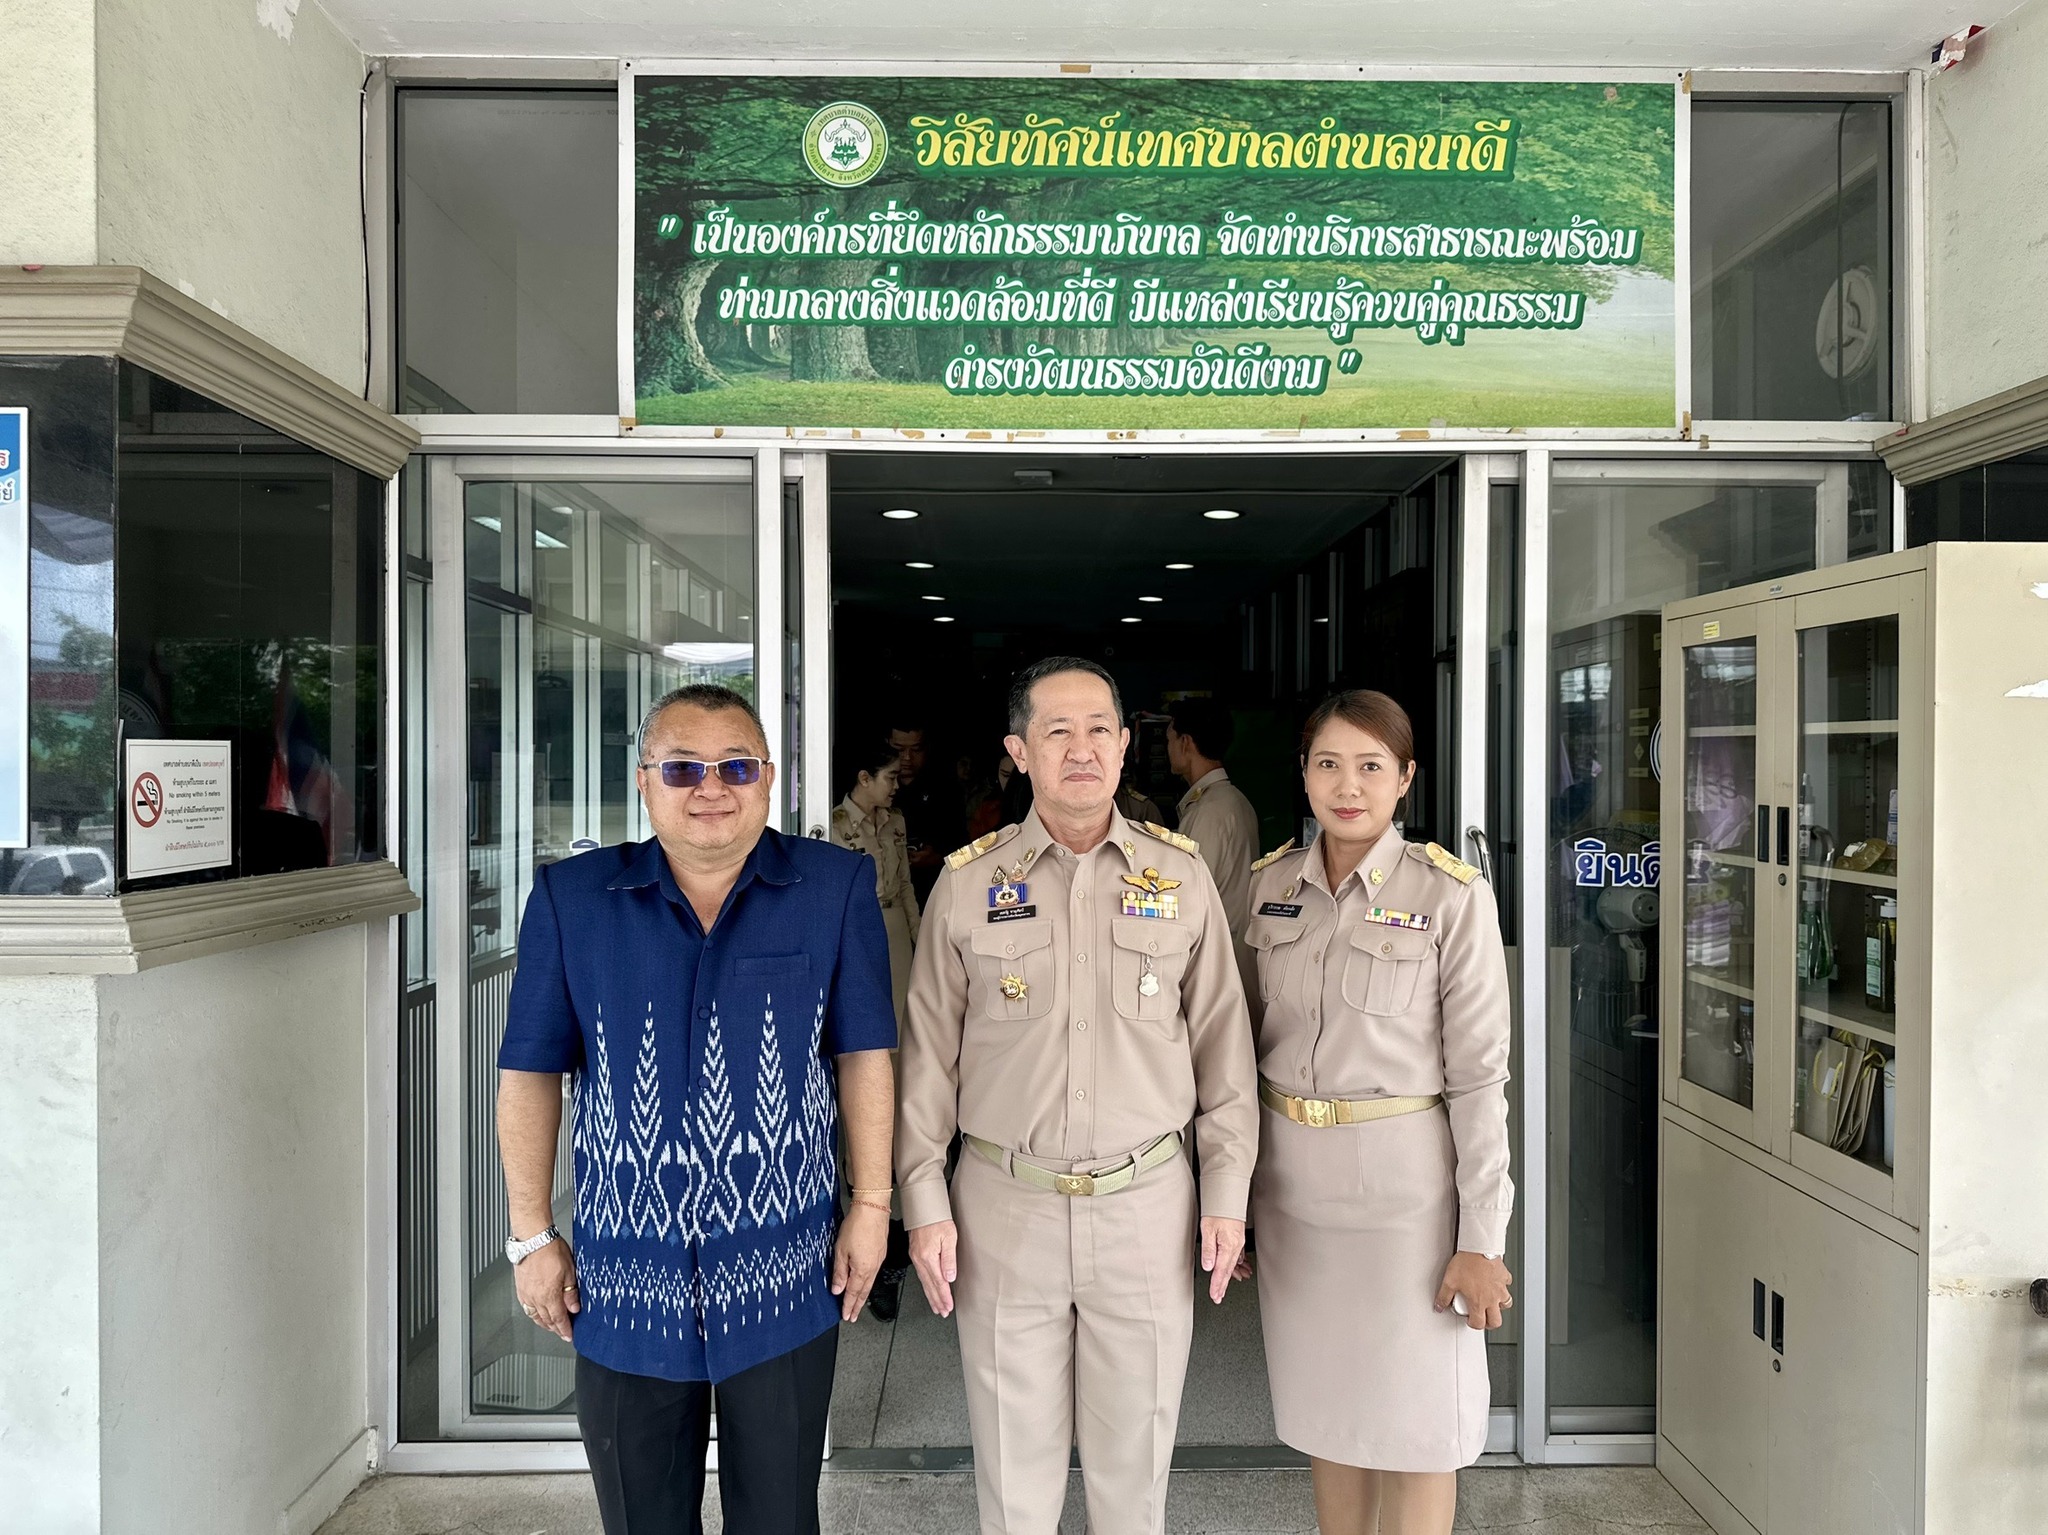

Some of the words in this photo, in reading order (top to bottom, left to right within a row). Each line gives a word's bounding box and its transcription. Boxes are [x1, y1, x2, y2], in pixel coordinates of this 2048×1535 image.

[910, 111, 1511, 171] วิสัยทัศน์เทศบาลตำบลนาดี
[695, 200, 1201, 255] เป็นองค์กรที่ยึดหลักธรรมาภิบาล
[1217, 211, 1637, 259] จัดทำบริการสาธารณะพร้อม
[719, 266, 1117, 322] ท่ามกลางสิ่งแวดล้อมที่ดี
[1130, 277, 1579, 339] มีแหล่งเรียนรู้ควบคู่คุณธรรม
[945, 344, 1325, 389] ดำรงวัฒนธรรมอันดีงาม
